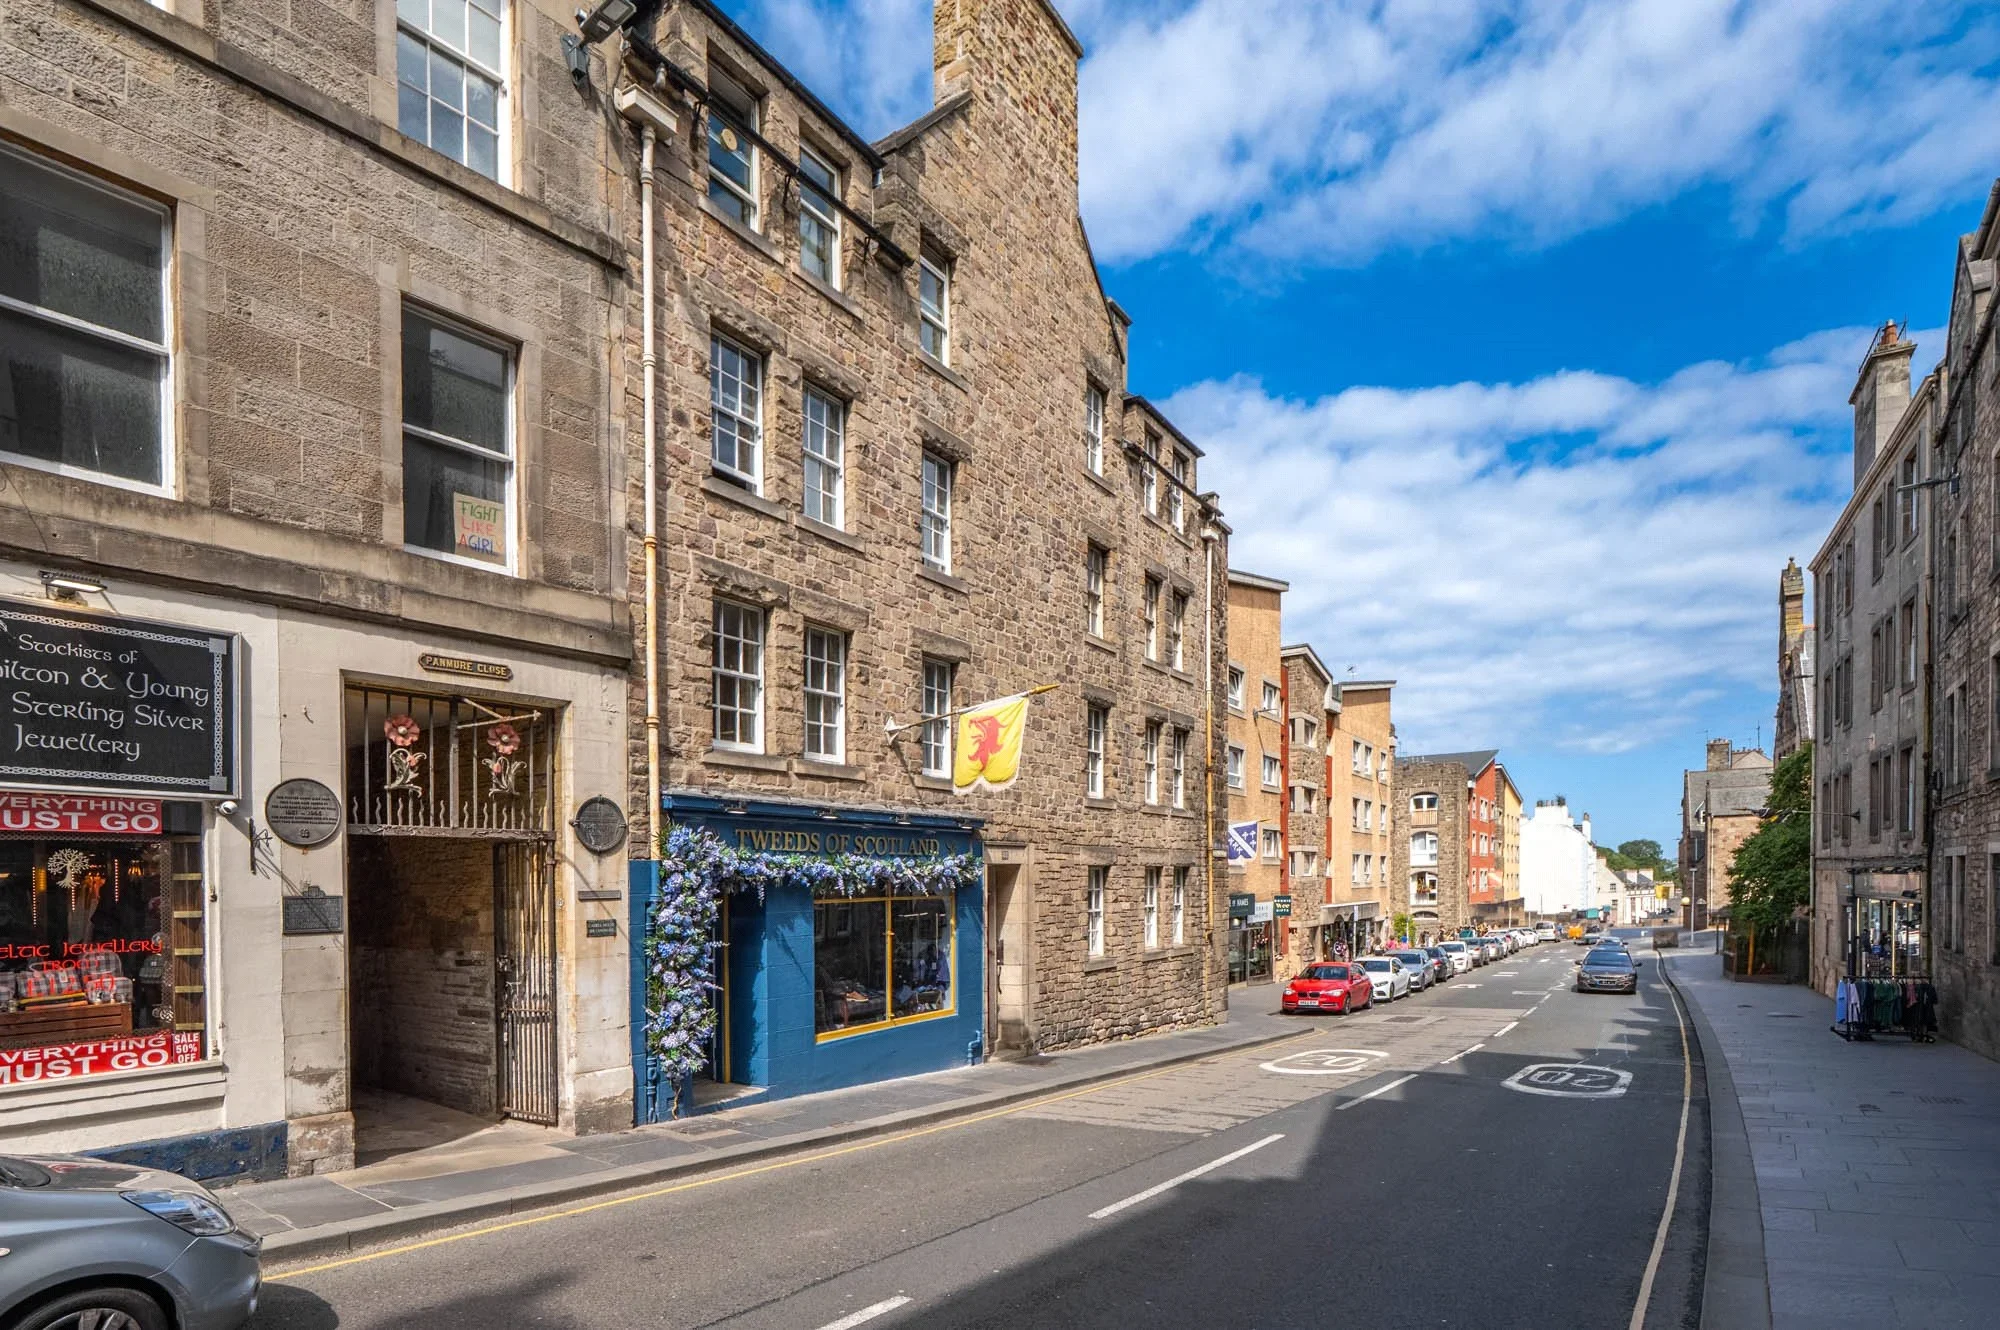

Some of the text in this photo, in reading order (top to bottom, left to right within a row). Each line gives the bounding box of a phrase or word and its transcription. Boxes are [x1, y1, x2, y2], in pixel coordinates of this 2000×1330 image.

[457, 500, 503, 524] FIGHT
[461, 517, 496, 537] LIKE
[459, 533, 500, 557] A GIRL
[18, 633, 138, 664] Stockists of
[426, 656, 507, 676] PANMURE CLOSE
[80, 667, 115, 690] &
[126, 671, 209, 706] Young
[12, 691, 205, 731] Sterling Silver
[14, 723, 140, 762] Jewellery
[100, 813, 159, 832] GO
[735, 829, 940, 856] TWEEDS OF SCOTLAND
[175, 1032, 199, 1044] SALE
[175, 1043, 198, 1054] 50%
[0, 1037, 166, 1063] VERYTHING
[111, 1049, 169, 1070] GO
[177, 1053, 196, 1064] OFF
[1299, 1054, 1370, 1067] 20
[1527, 1070, 1608, 1089] 20
